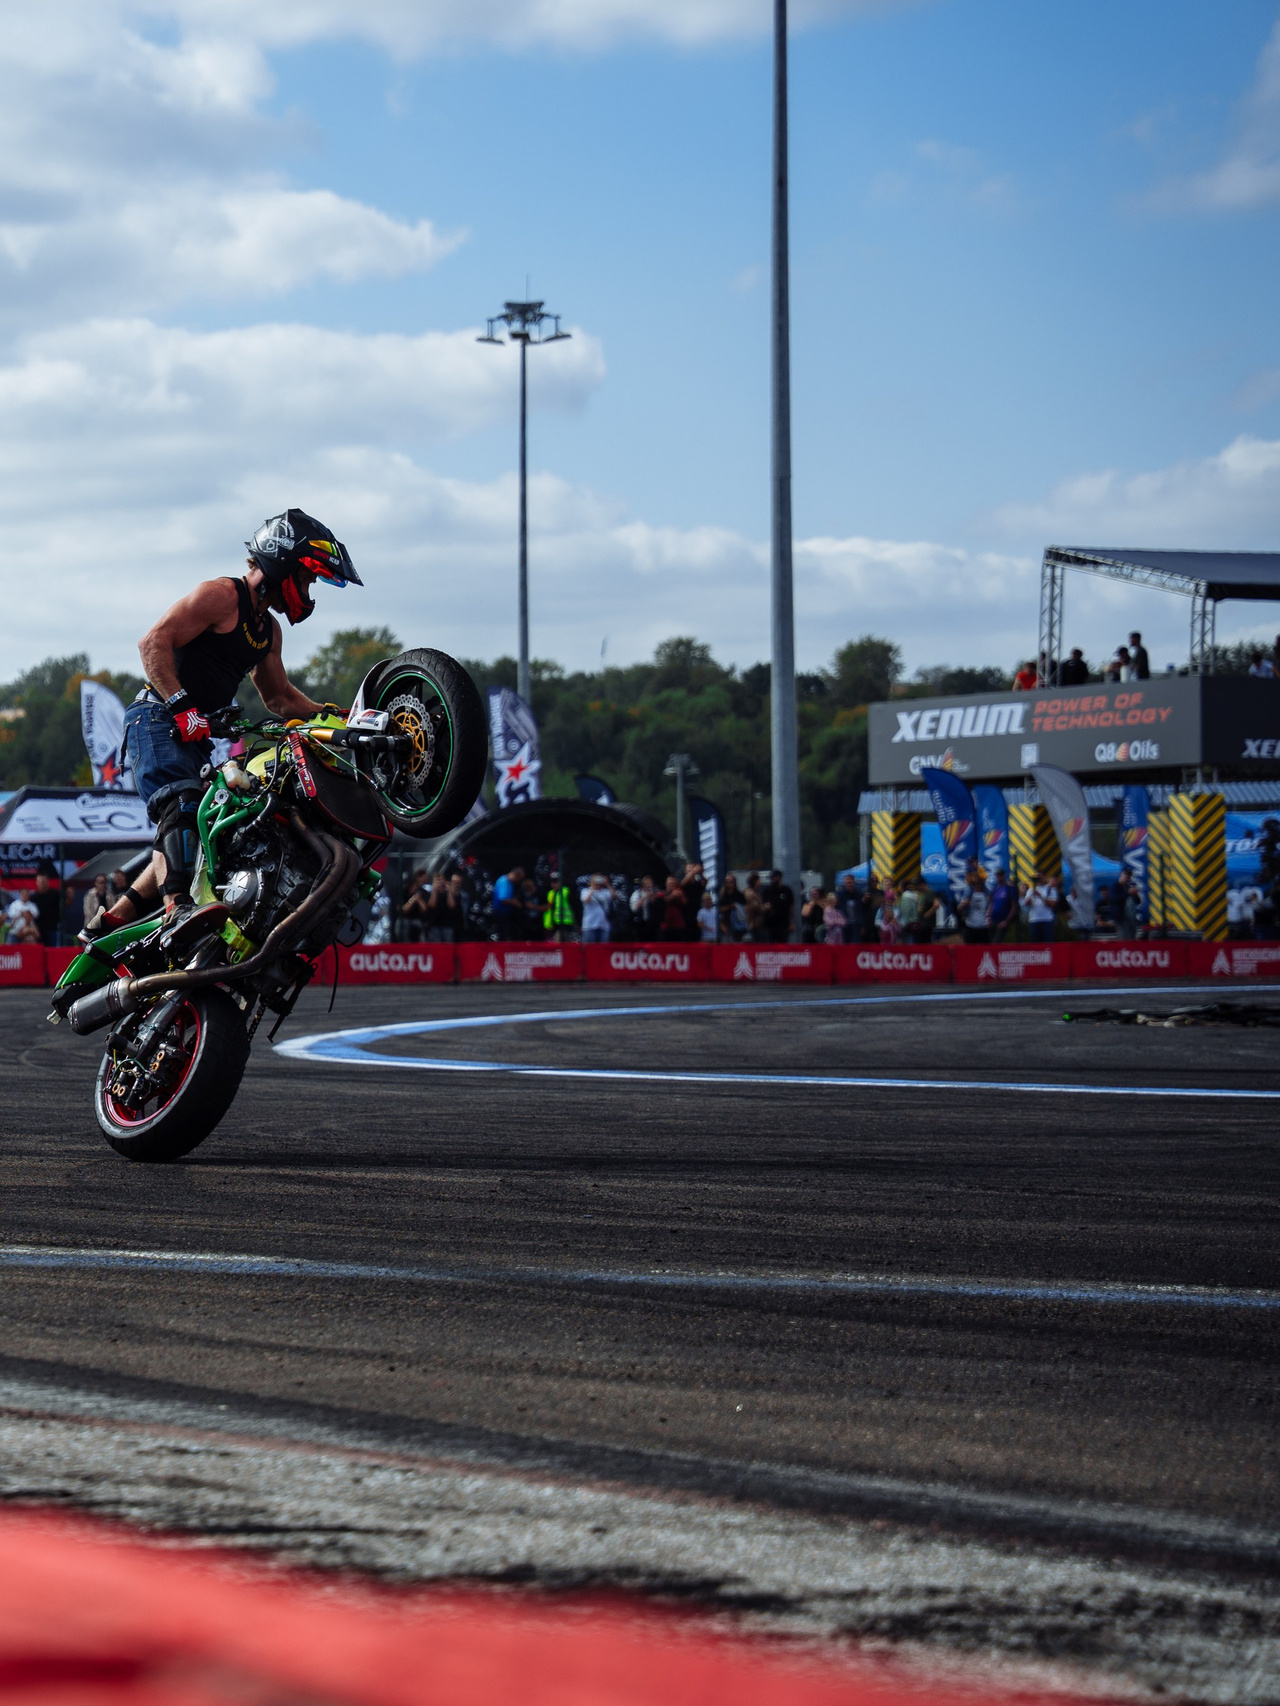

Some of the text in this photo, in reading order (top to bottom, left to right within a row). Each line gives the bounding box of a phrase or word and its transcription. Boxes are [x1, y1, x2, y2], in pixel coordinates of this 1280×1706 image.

[1034, 692, 1144, 715] POWER OF
[891, 702, 1026, 743] XENUM
[1032, 706, 1172, 732] TECHNOLOGY
[1095, 740, 1160, 763] Q8 Oils
[56, 811, 157, 832] LEC
[0, 844, 56, 860] LECAR
[350, 951, 433, 972] auto.ru
[610, 950, 690, 972] auto.ru
[857, 949, 933, 971] auto.ru
[999, 948, 1052, 966] МОСКОВСКИЙ
[1096, 949, 1169, 968] auto.ru
[755, 965, 784, 981] СПОРТ
[999, 963, 1025, 979] СПОРТ
